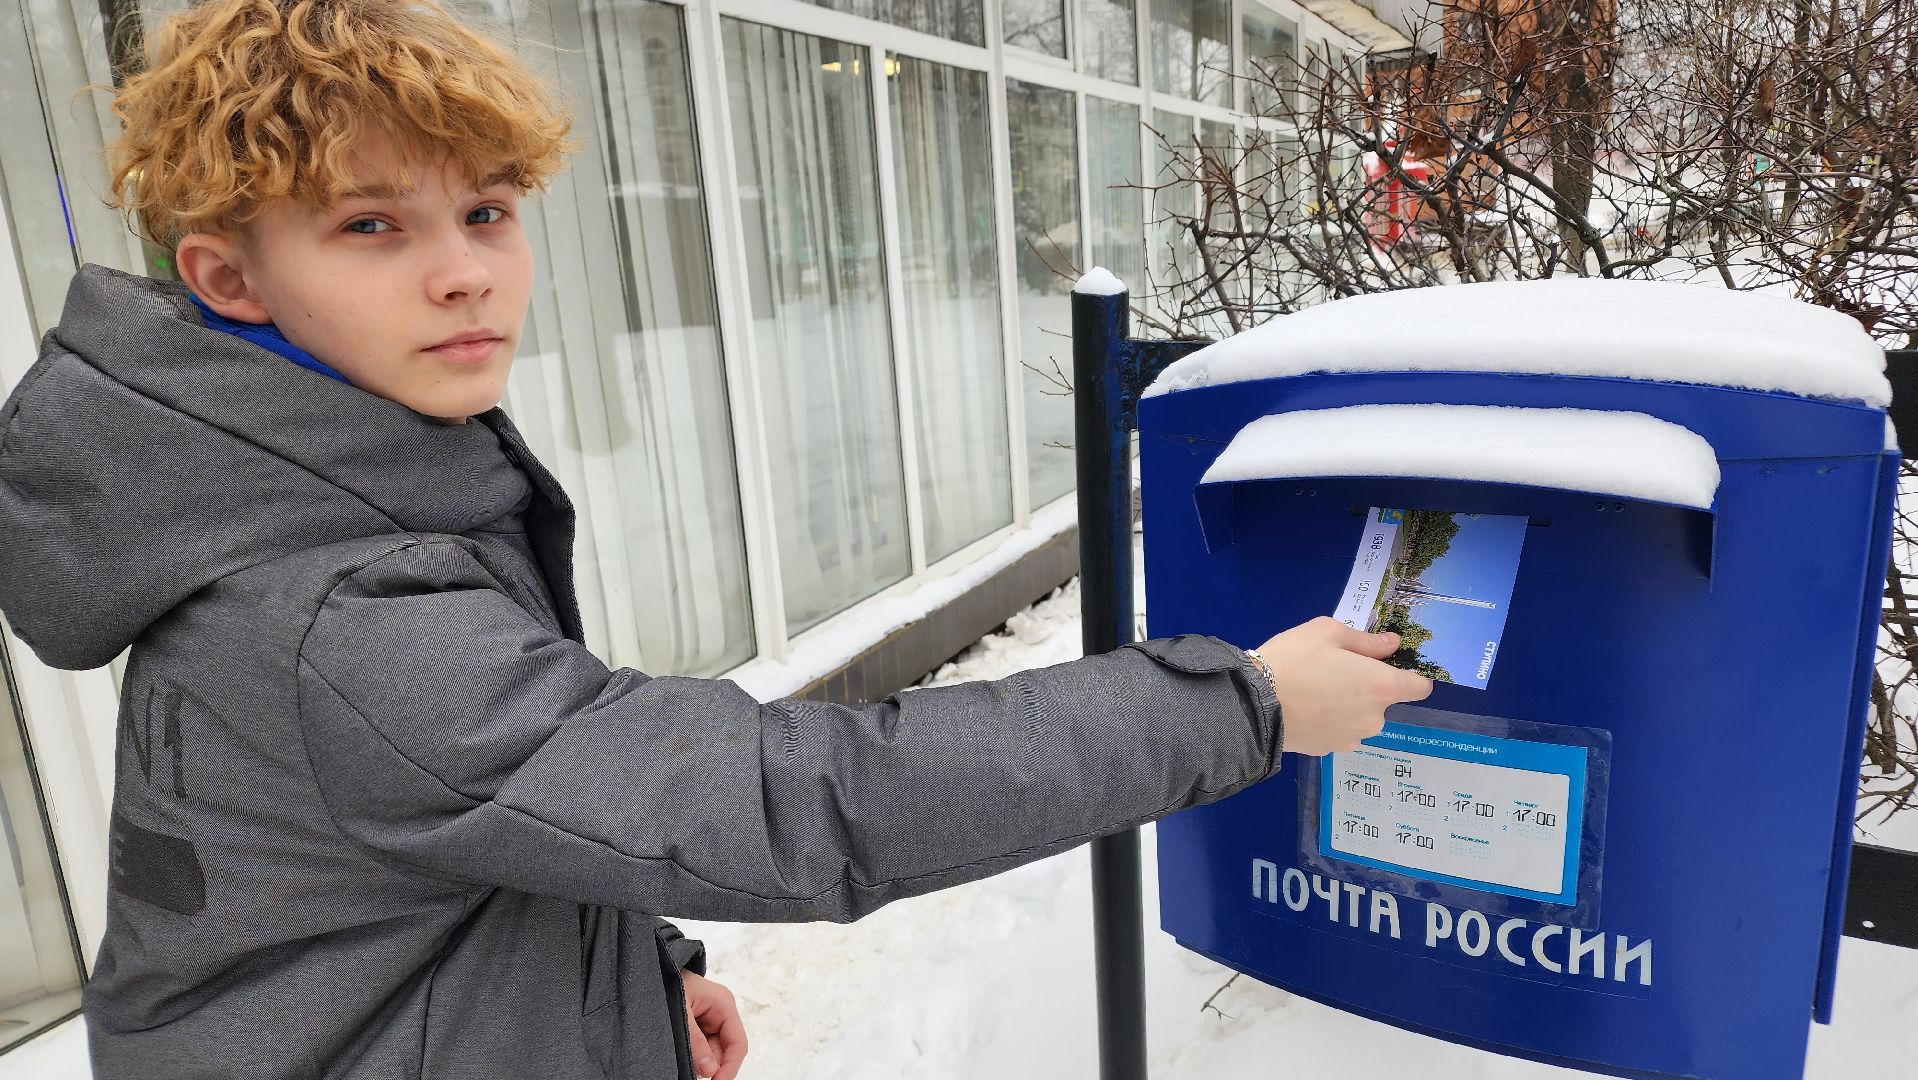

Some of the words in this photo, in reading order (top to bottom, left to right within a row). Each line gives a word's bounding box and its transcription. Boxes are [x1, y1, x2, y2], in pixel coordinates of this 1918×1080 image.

[1476, 640, 1497, 680] СТУПИНО
[1408, 736, 1498, 755] корреспонденции
[1344, 779, 1381, 798] 17:00
[1397, 790, 1436, 808] 17:00
[1453, 800, 1495, 818] 17:00
[1513, 809, 1556, 827] 17:00
[1342, 820, 1379, 838] 17:00
[1395, 832, 1434, 850] 17:00
[1252, 858, 1400, 939] ПОЧТА
[1425, 902, 1652, 986] РОССИИ
